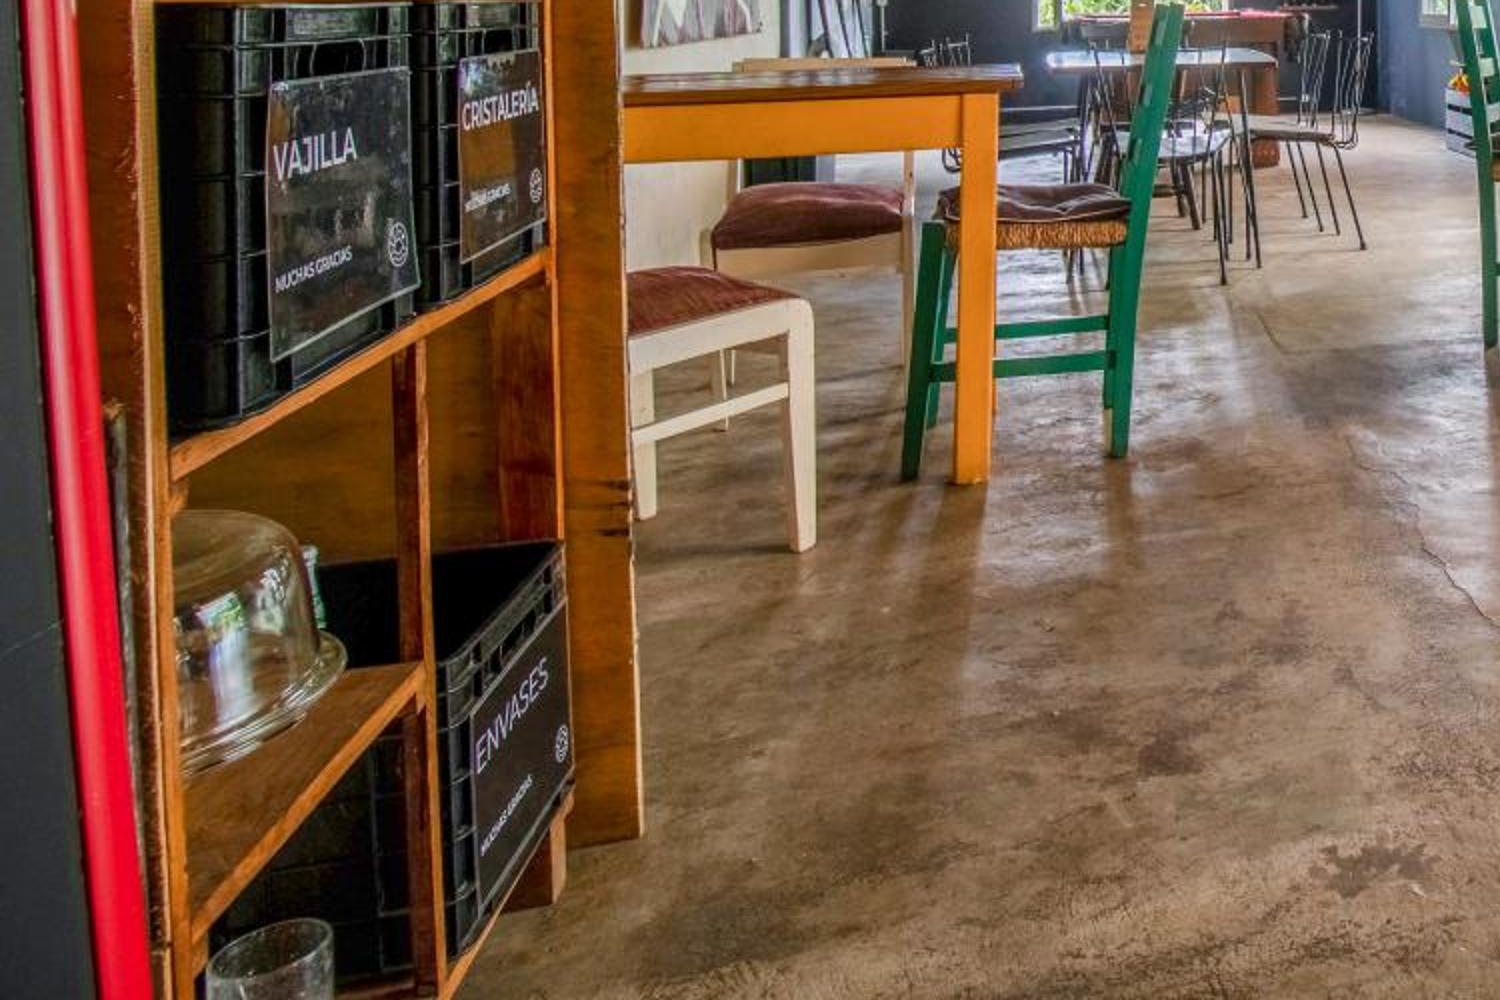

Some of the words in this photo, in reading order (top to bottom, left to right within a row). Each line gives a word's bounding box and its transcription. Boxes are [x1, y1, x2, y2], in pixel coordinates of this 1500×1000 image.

[462, 81, 539, 131] CRISTALERÍA
[273, 126, 357, 181] VAJILLA
[275, 261, 315, 294] MUCHAS
[315, 244, 353, 274] GRACIAS
[476, 657, 549, 775] ENVASES
